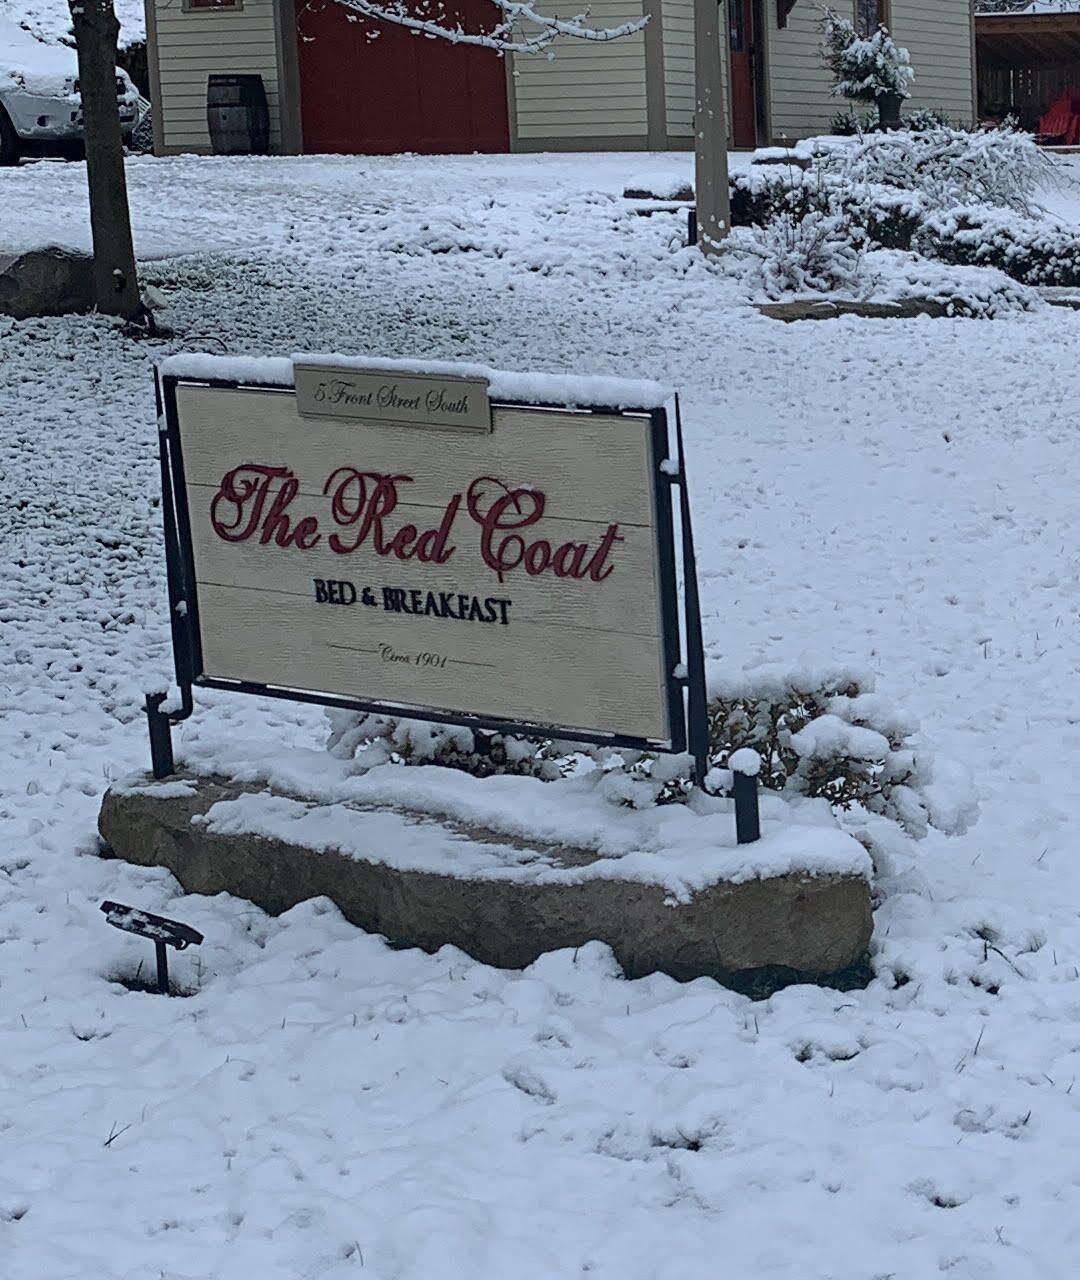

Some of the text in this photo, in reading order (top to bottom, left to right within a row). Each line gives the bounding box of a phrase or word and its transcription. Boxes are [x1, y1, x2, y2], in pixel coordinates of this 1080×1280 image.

[314, 379, 468, 414] 5 Front Street South
[210, 464, 624, 583] The Red Coat
[313, 578, 512, 625] BED & BREAKFAST
[378, 642, 448, 668] Circa 1901
